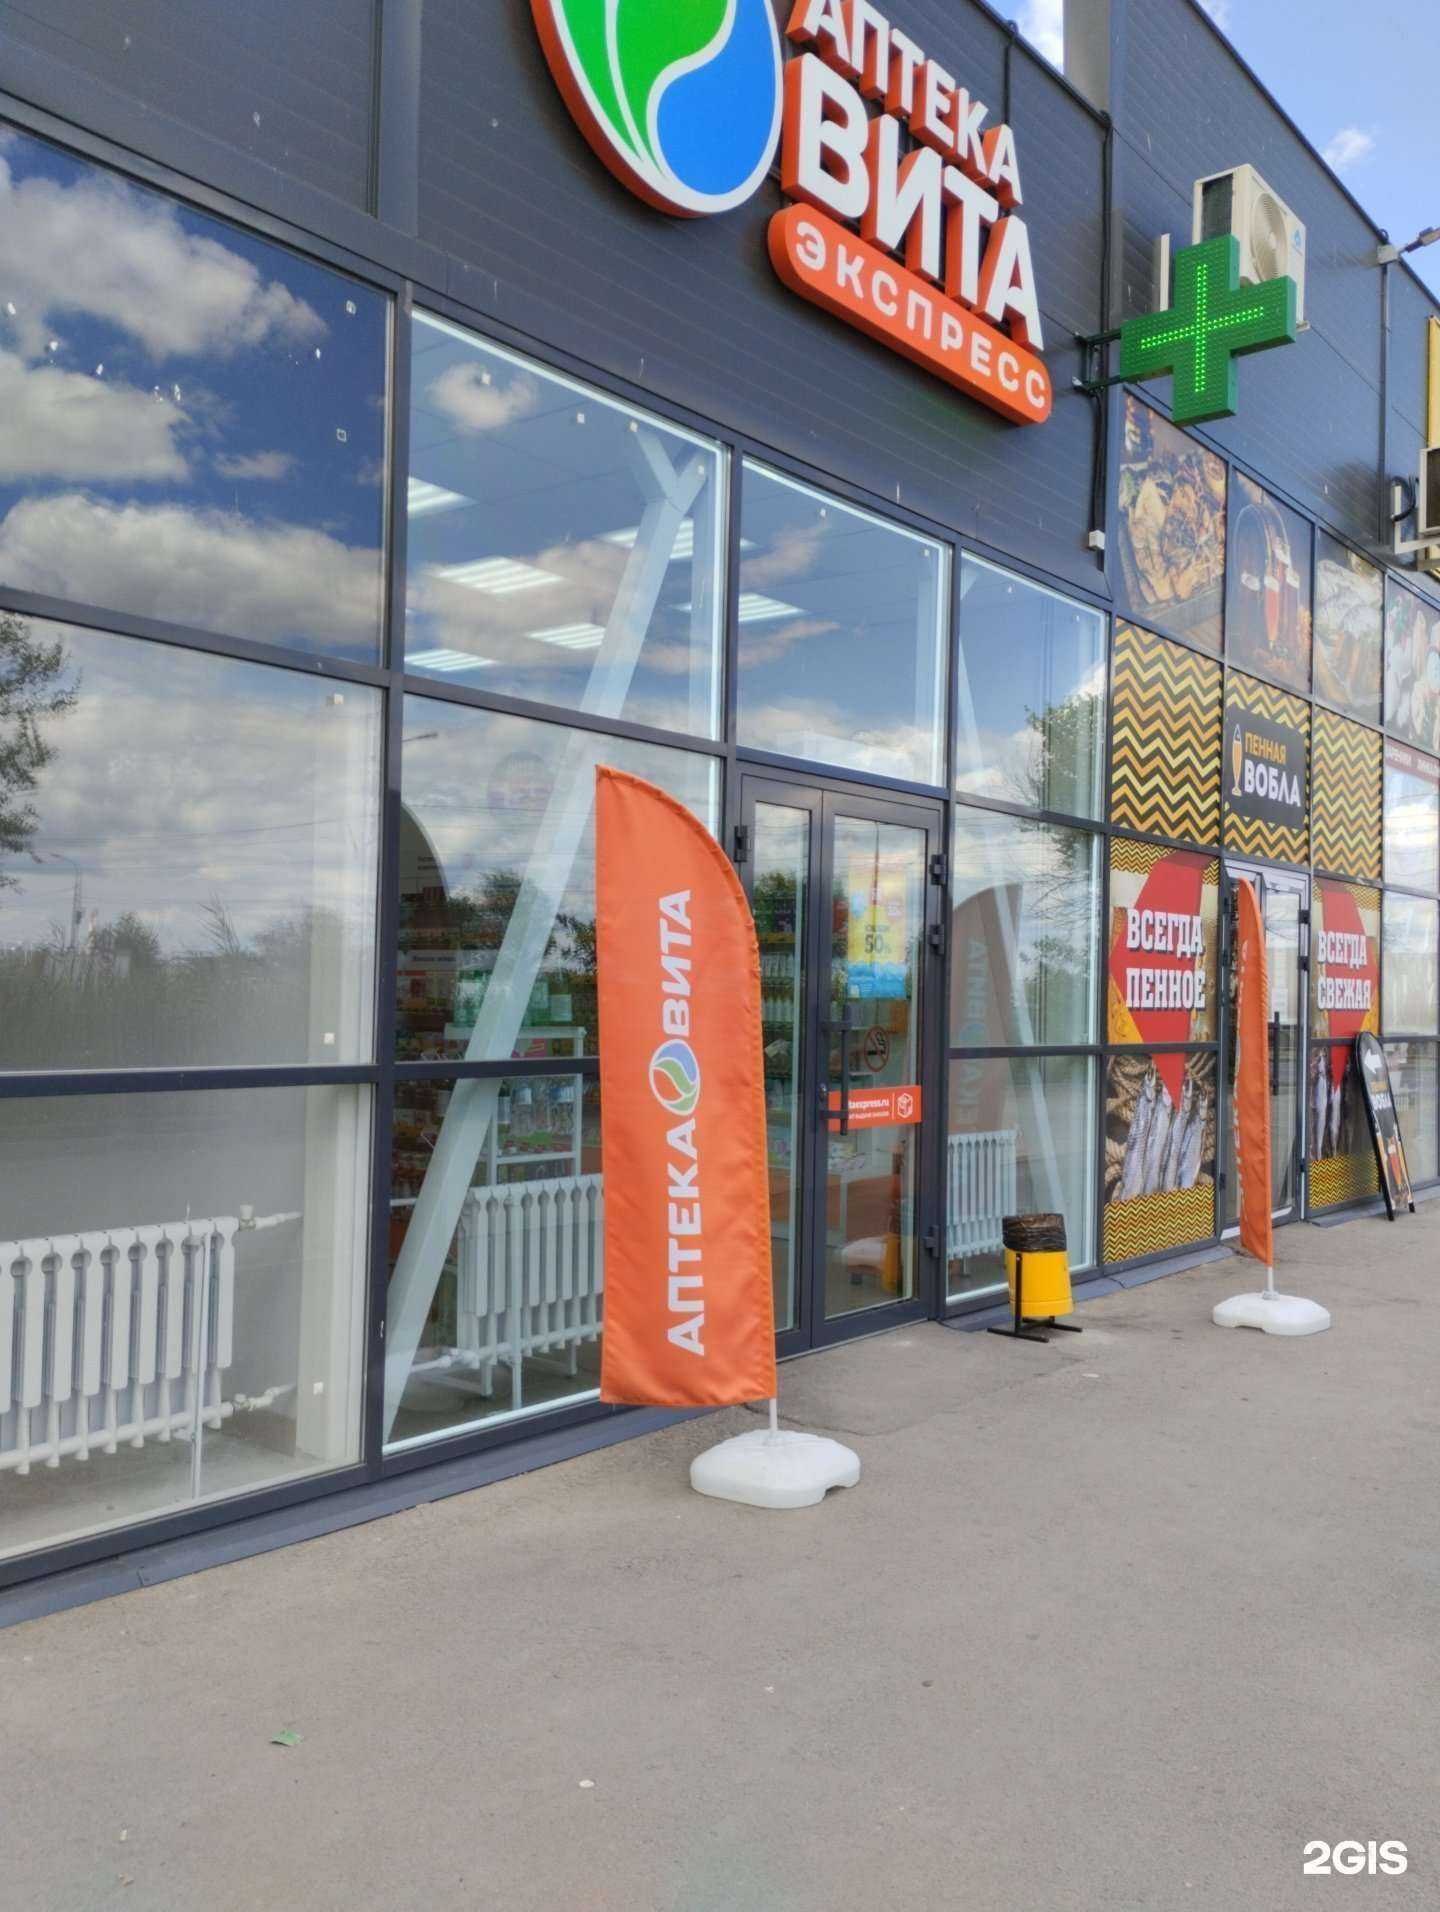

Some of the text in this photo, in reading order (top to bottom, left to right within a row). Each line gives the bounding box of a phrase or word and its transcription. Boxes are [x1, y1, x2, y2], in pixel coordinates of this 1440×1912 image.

[799, 0, 1023, 205] АПТЕКА
[796, 52, 1044, 352] ВИТА
[795, 221, 1046, 409] ЭКСПРЕСС
[1245, 732, 1287, 766] ПЕННАЯ
[1244, 759, 1302, 807] ВОБЛА
[1126, 908, 1204, 959] ВСЕГДА
[1317, 930, 1367, 970] ВСЕГДА
[1125, 967, 1206, 1009] ПЕННОЕ
[1317, 976, 1372, 1009] СВЕЖАЯ
[658, 889, 705, 1357] АПТЕКА ВИТА
